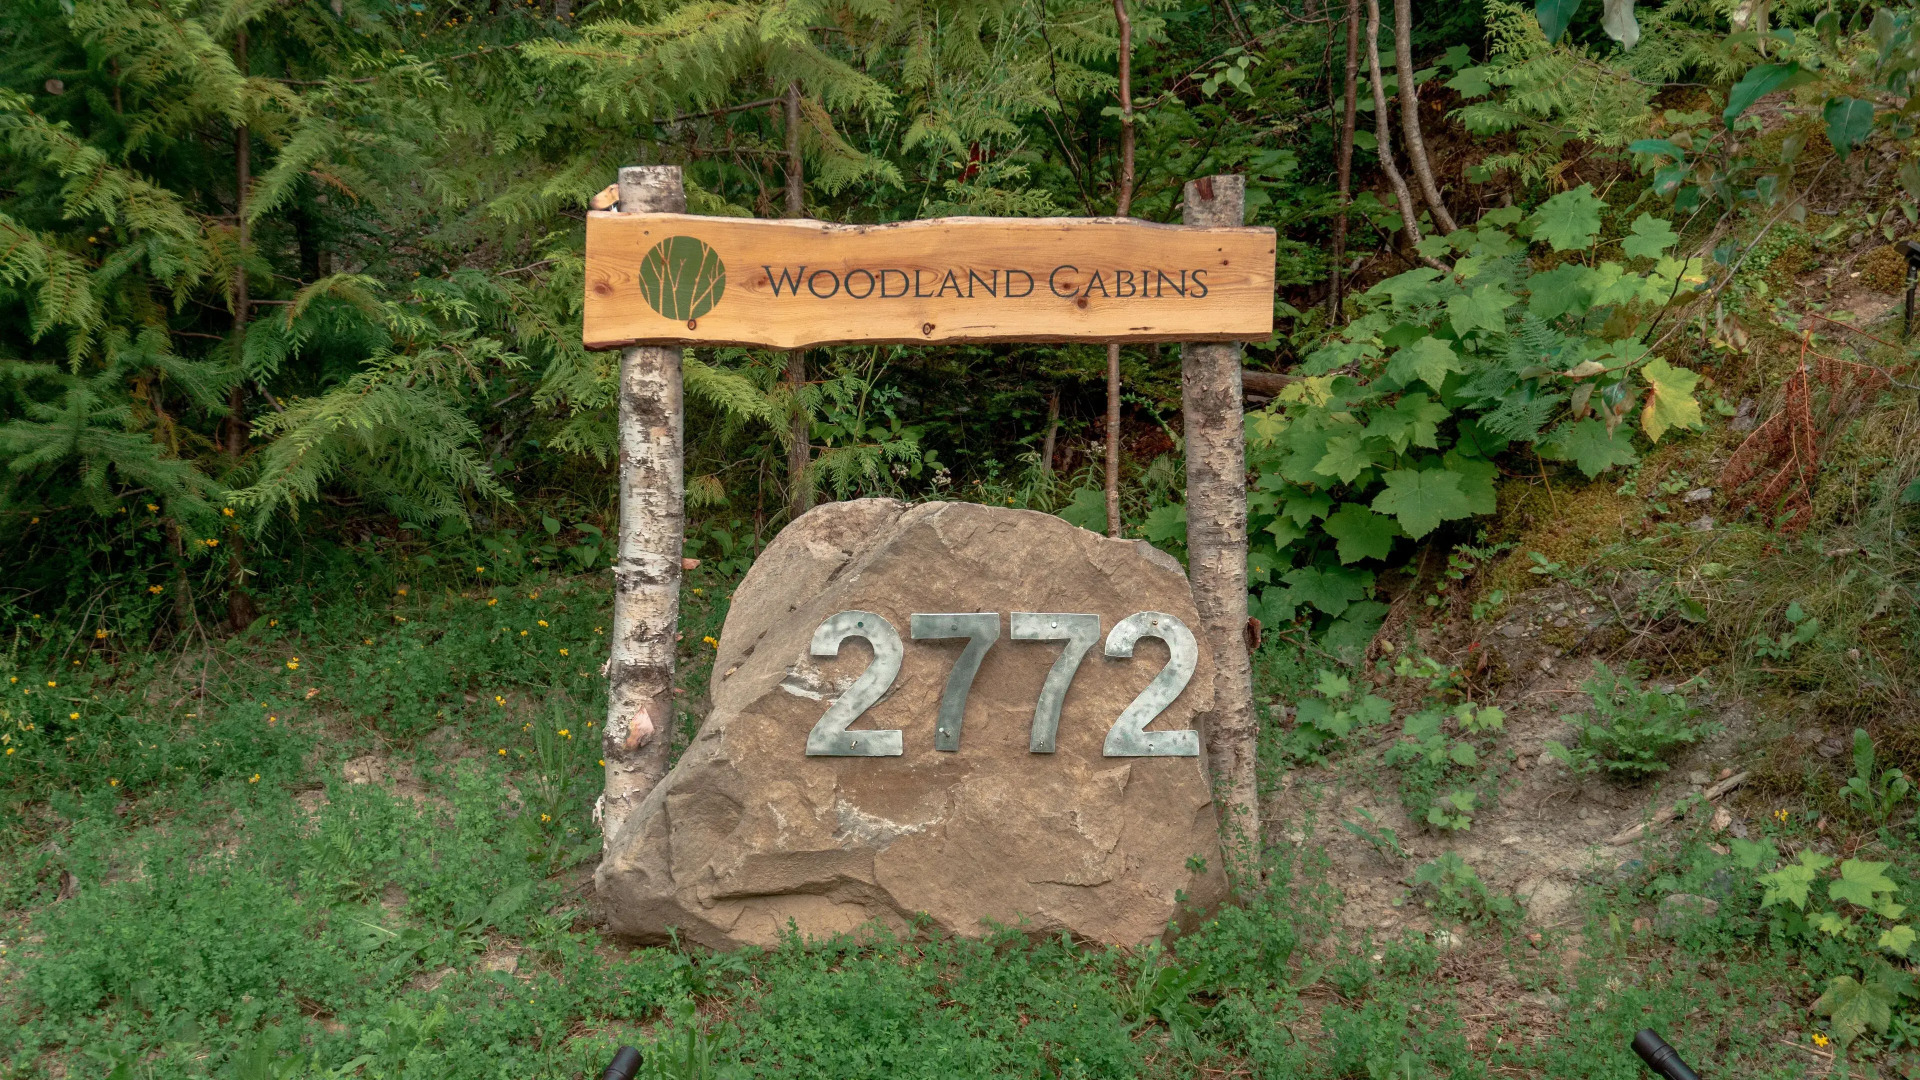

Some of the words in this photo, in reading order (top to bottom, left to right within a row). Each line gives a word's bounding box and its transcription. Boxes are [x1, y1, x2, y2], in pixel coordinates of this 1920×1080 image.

[762, 265, 1035, 299] WOODLAND
[1048, 264, 1209, 299] CABINS
[806, 610, 1200, 757] 2772
